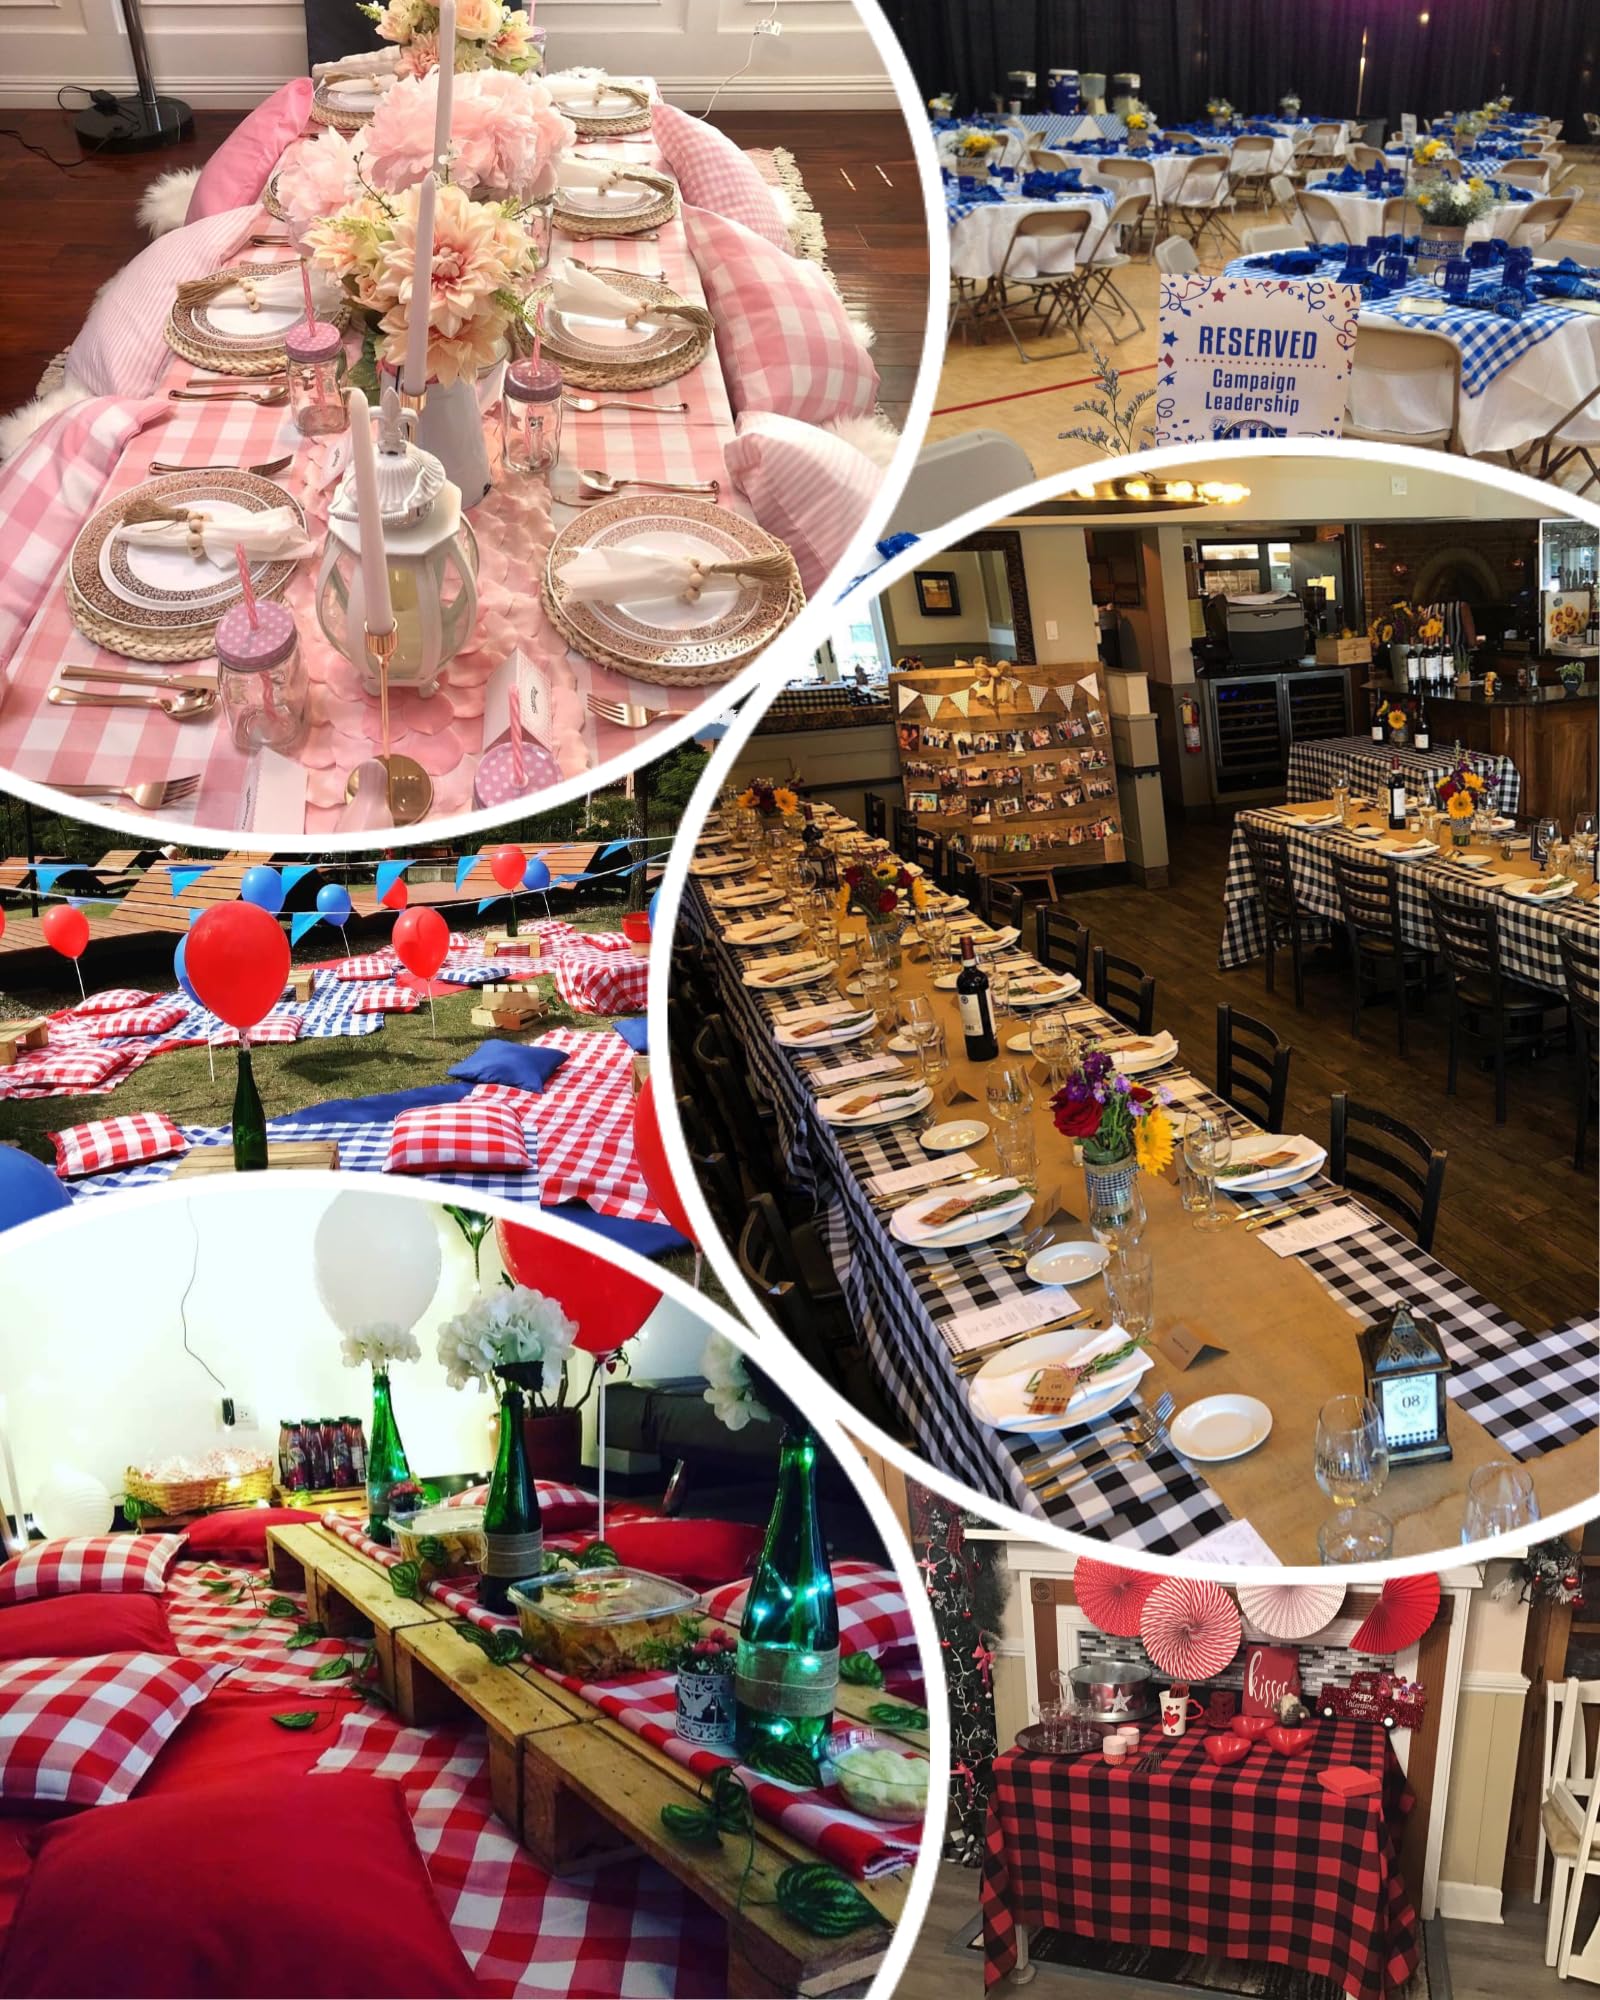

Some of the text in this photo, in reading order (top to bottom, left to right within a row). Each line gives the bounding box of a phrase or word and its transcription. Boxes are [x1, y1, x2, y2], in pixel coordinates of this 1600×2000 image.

[1199, 325, 1318, 360] RESERVED
[1212, 368, 1297, 394] Campaign
[1205, 391, 1300, 416] Leadership
[1402, 1394, 1421, 1409] 08
